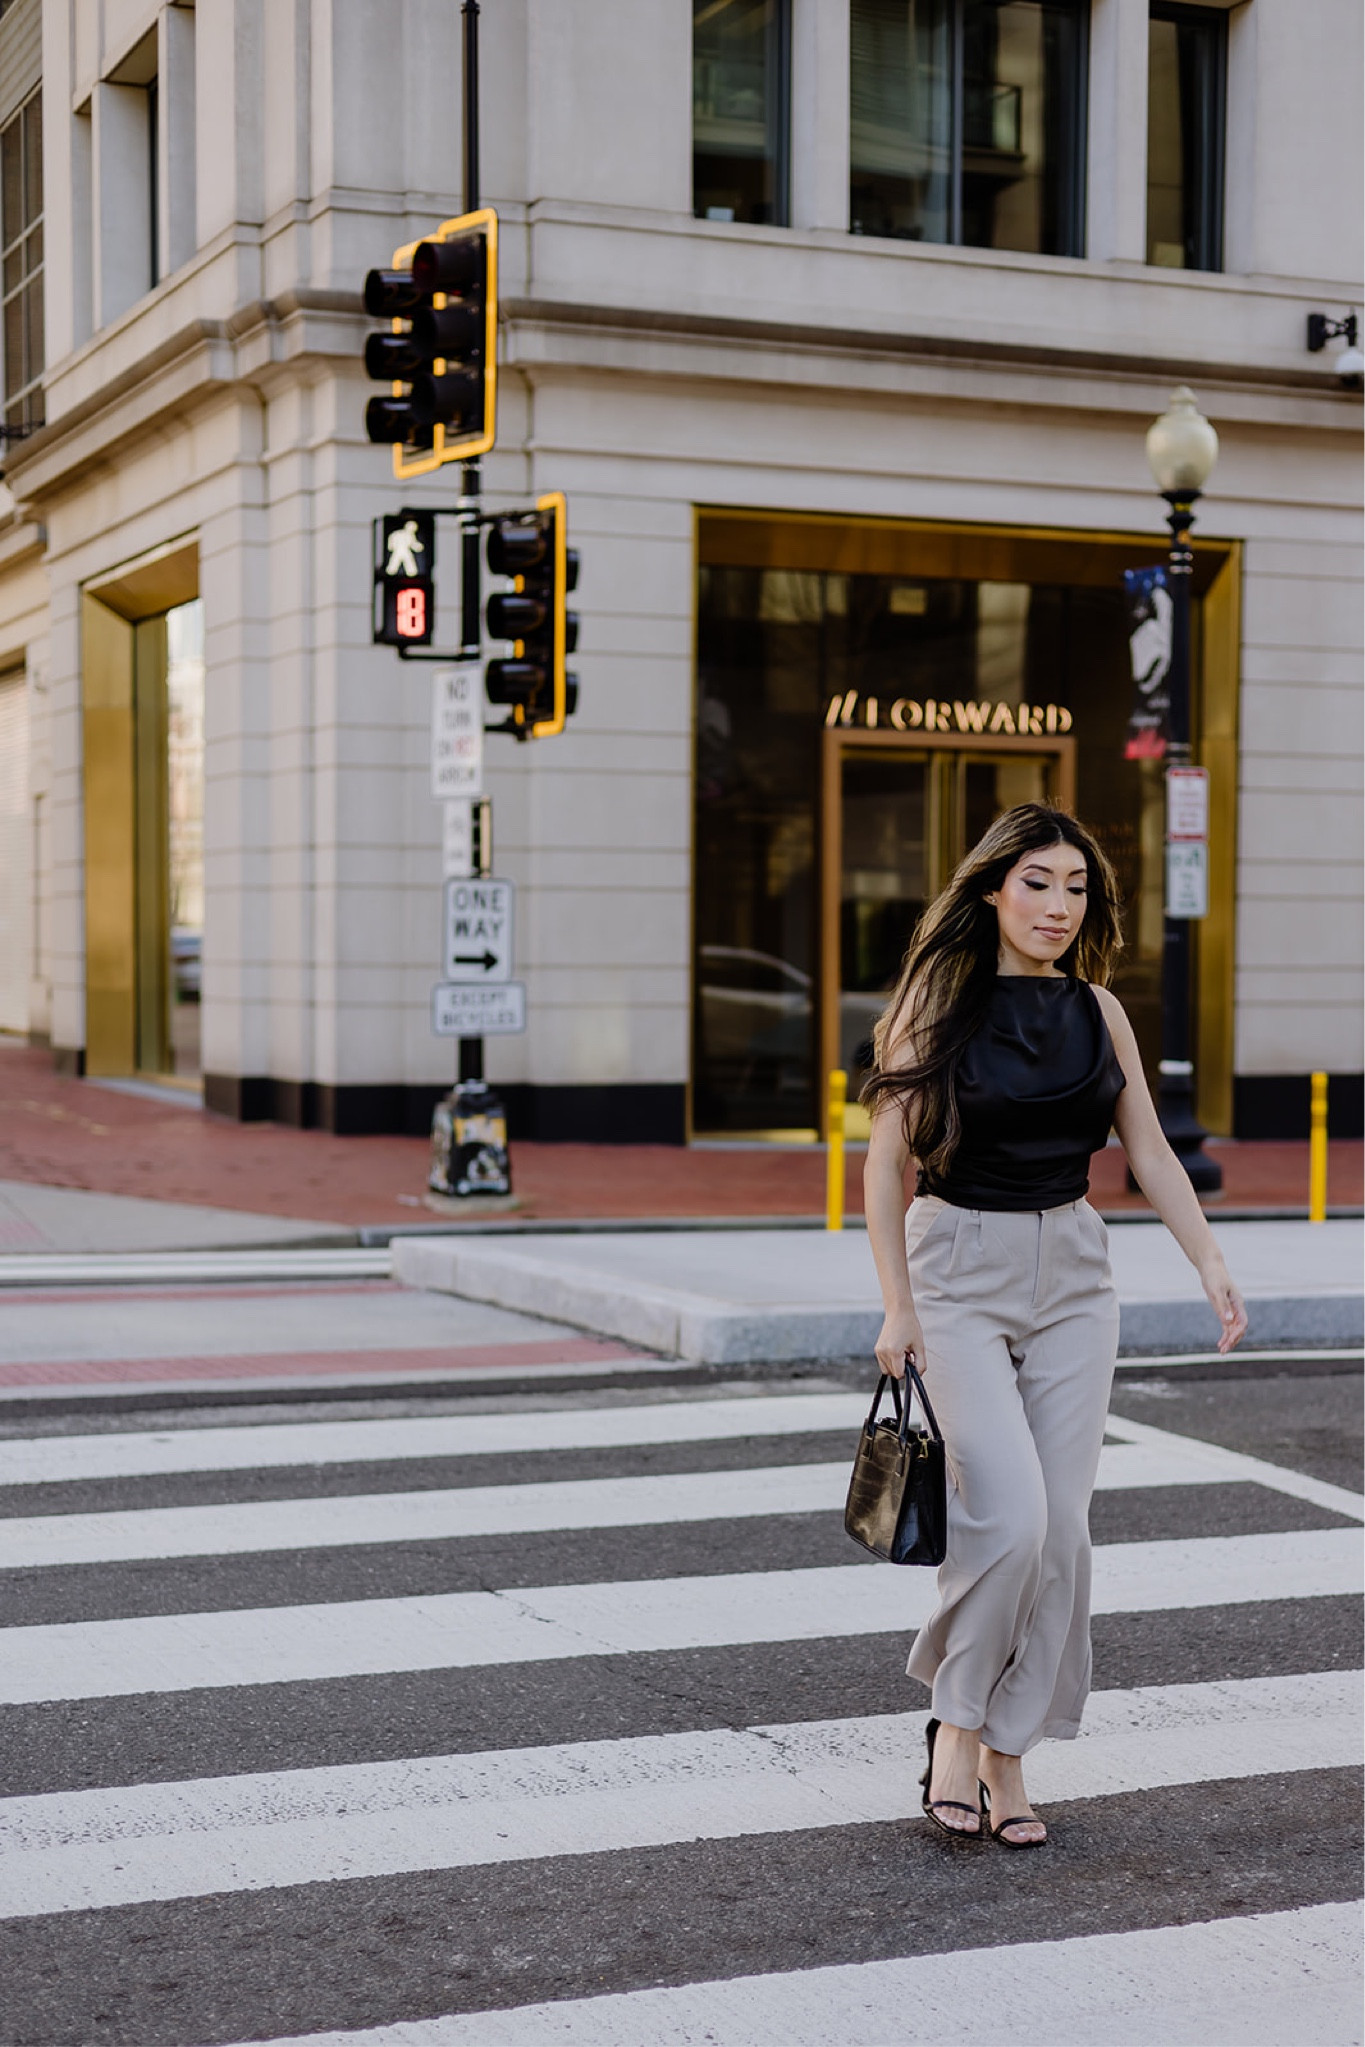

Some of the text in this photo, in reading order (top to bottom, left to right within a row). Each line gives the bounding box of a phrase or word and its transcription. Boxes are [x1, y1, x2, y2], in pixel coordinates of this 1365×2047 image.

[397, 588, 425, 637] 8
[453, 887, 504, 912] ONE
[454, 917, 504, 939] WAY
[450, 991, 507, 1006] EXCEPT
[442, 1010, 516, 1027] BICYCLES
